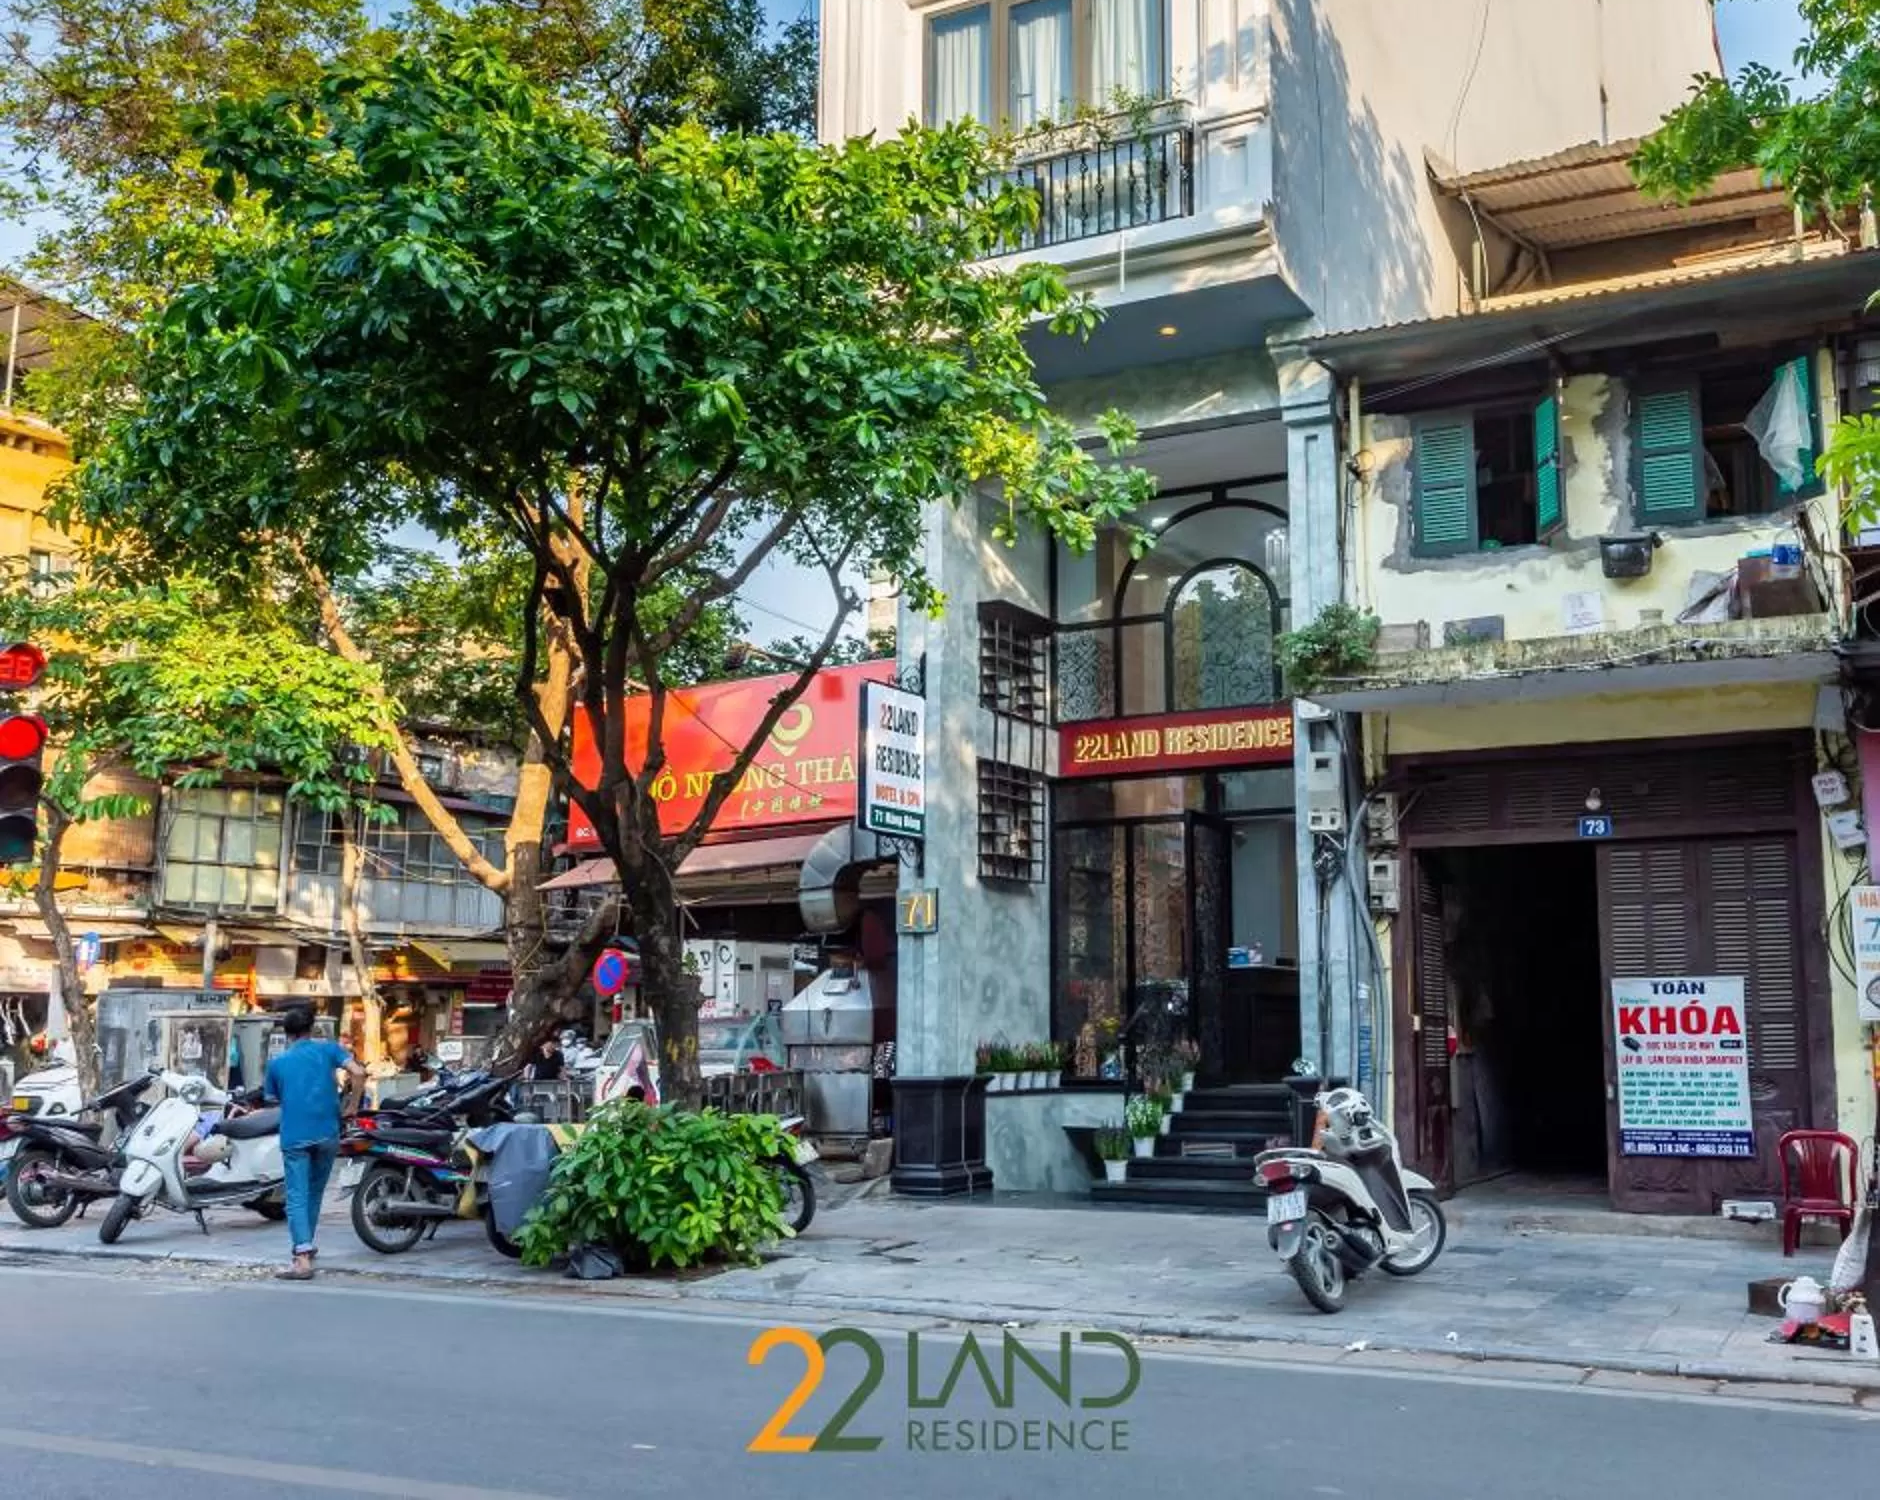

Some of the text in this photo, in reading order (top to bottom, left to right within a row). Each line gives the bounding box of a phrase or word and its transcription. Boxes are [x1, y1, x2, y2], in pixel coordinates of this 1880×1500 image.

[879, 703, 919, 737] 22LAND
[1074, 716, 1293, 763] 22LAND RESIDENCE
[875, 743, 921, 781] RESIDENCE
[876, 783, 897, 803] HOTEL
[1585, 819, 1605, 835] 73
[900, 894, 932, 929] 71
[1619, 1000, 1741, 1035] KHÓA
